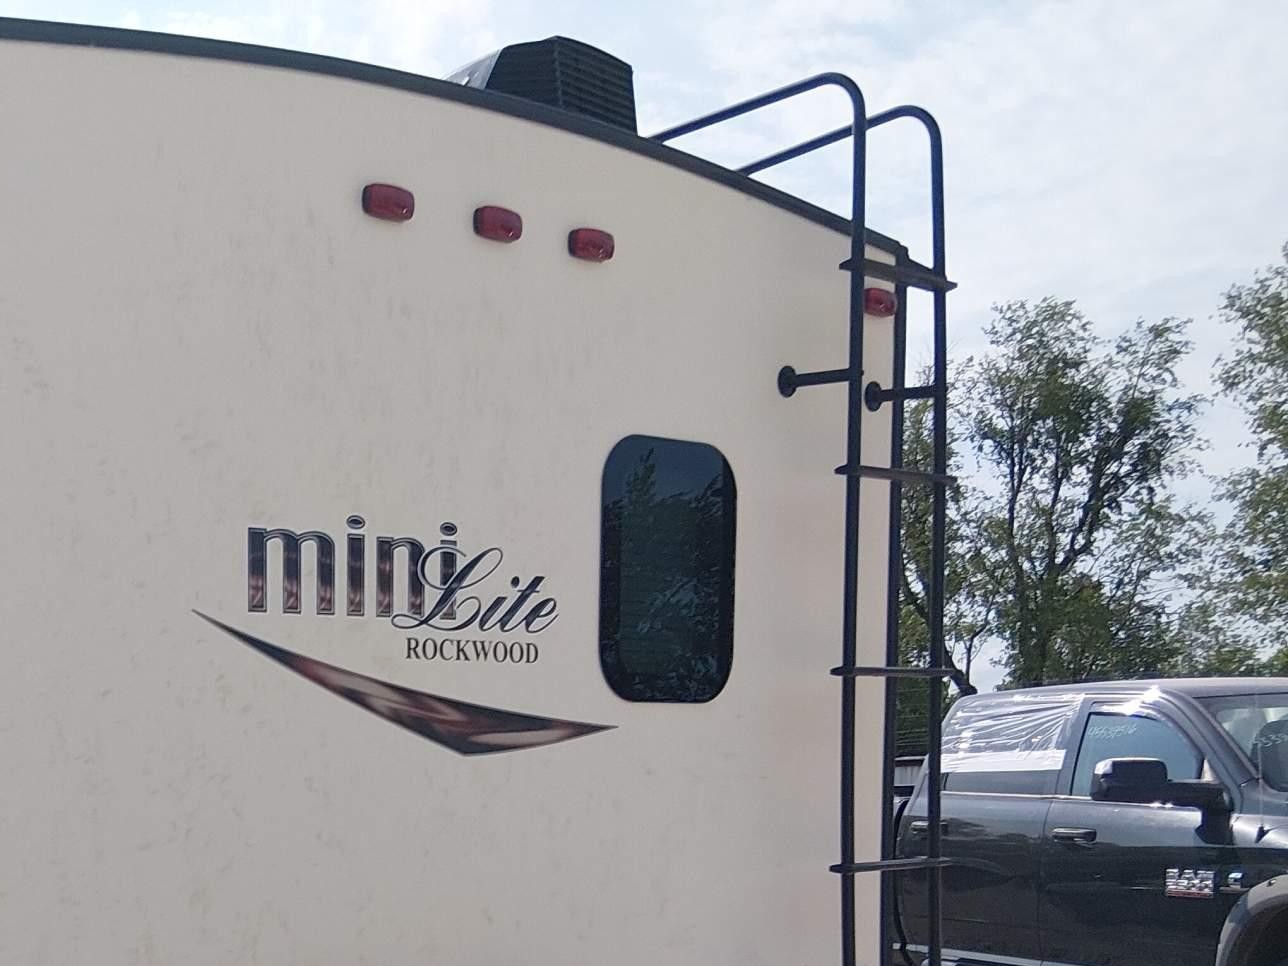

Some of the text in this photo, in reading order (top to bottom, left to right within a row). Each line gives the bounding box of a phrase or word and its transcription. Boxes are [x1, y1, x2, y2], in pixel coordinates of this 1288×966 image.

[247, 514, 559, 634] mini Lite
[404, 637, 540, 664] ROCKWOOD
